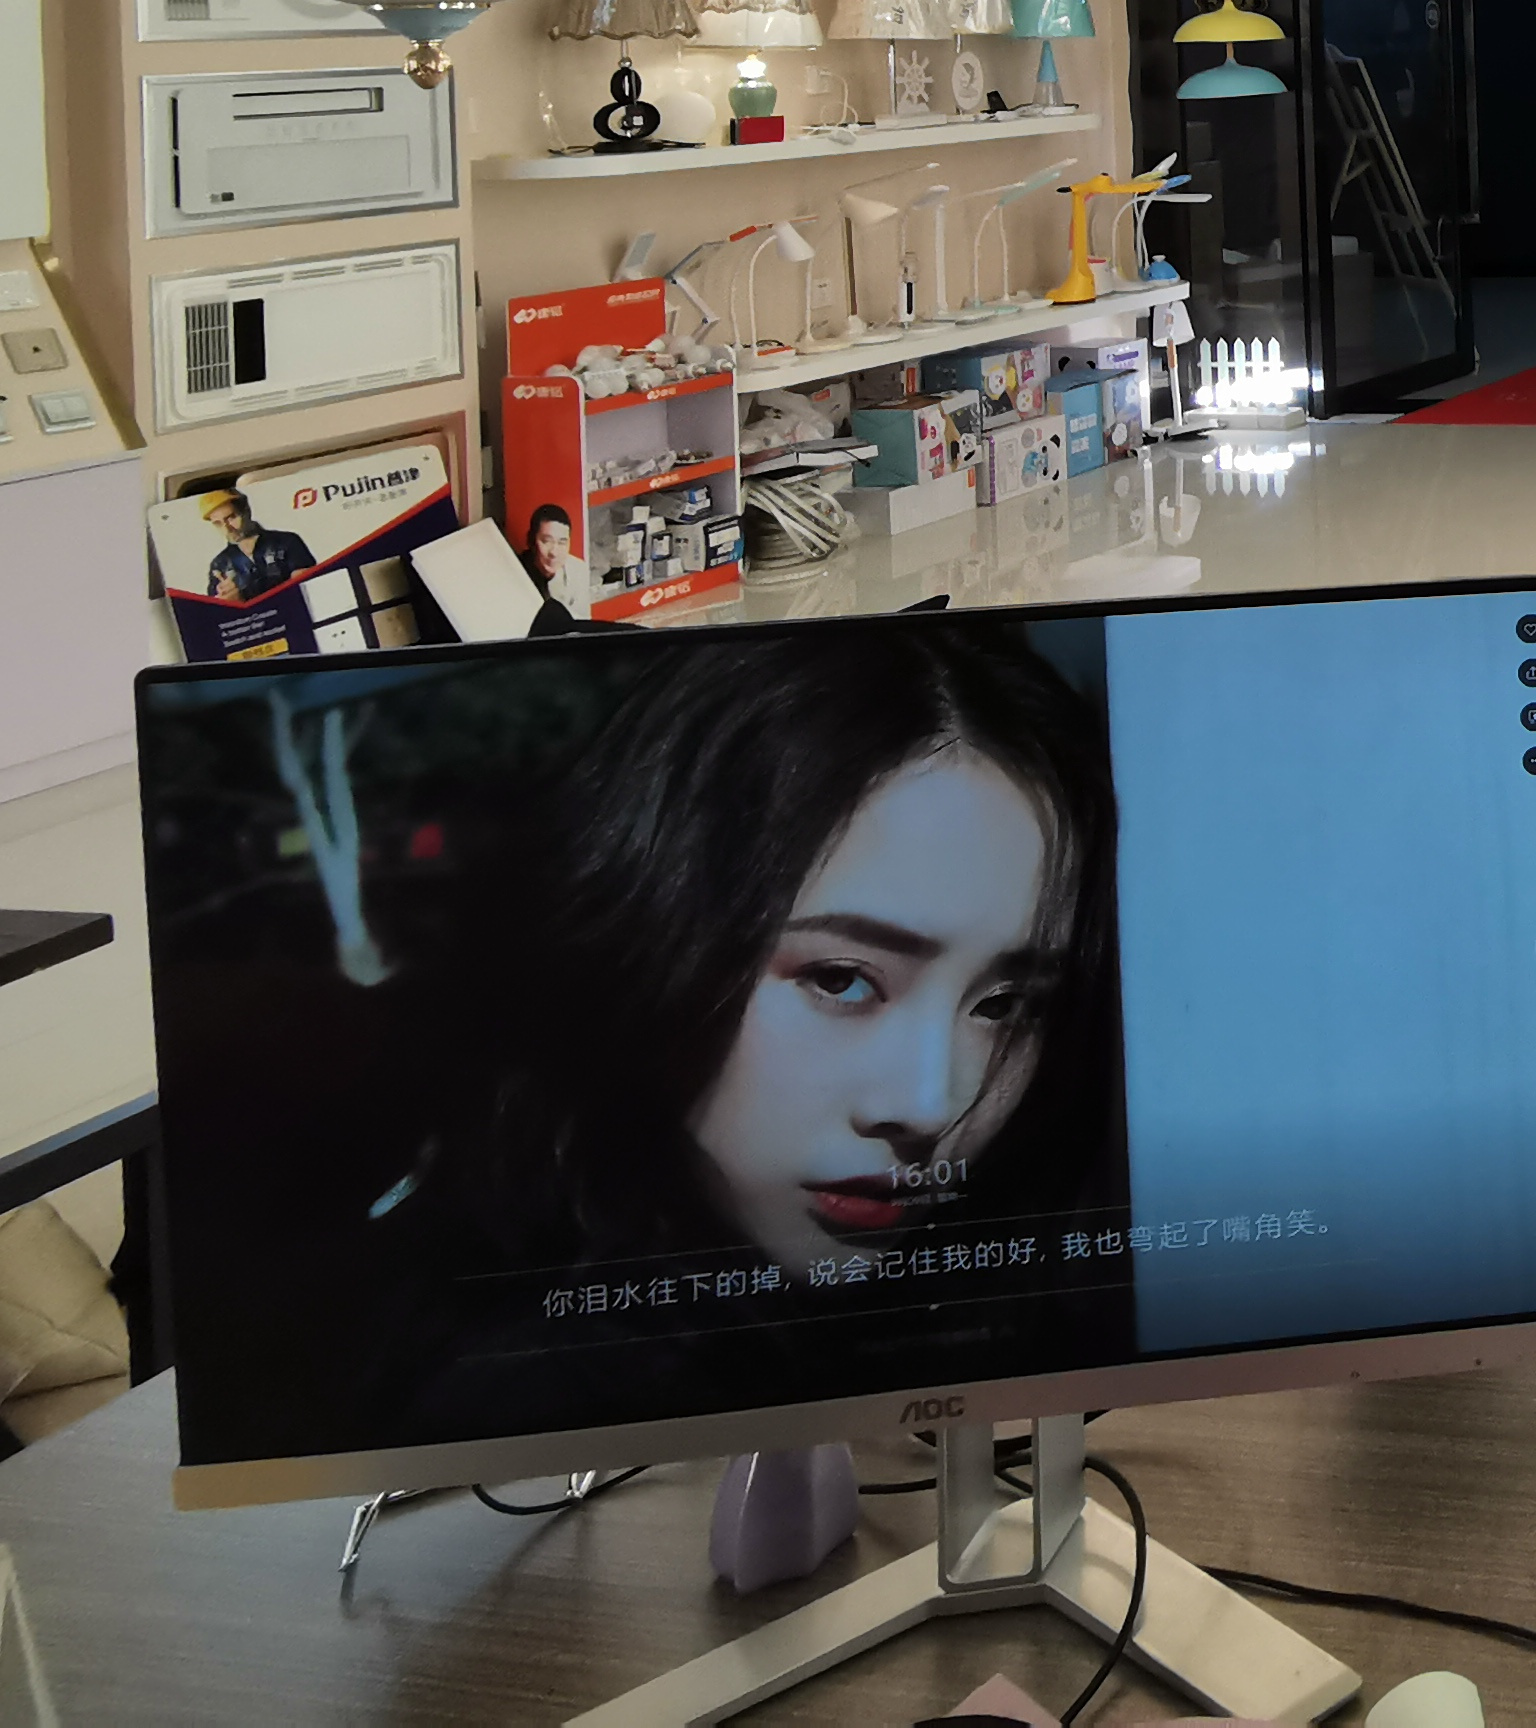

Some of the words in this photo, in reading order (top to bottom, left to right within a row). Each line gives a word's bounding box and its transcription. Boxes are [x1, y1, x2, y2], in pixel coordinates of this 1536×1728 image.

[322, 474, 386, 503] Pujin
[886, 1158, 968, 1190] 16:01
[899, 1395, 965, 1424] AOC
